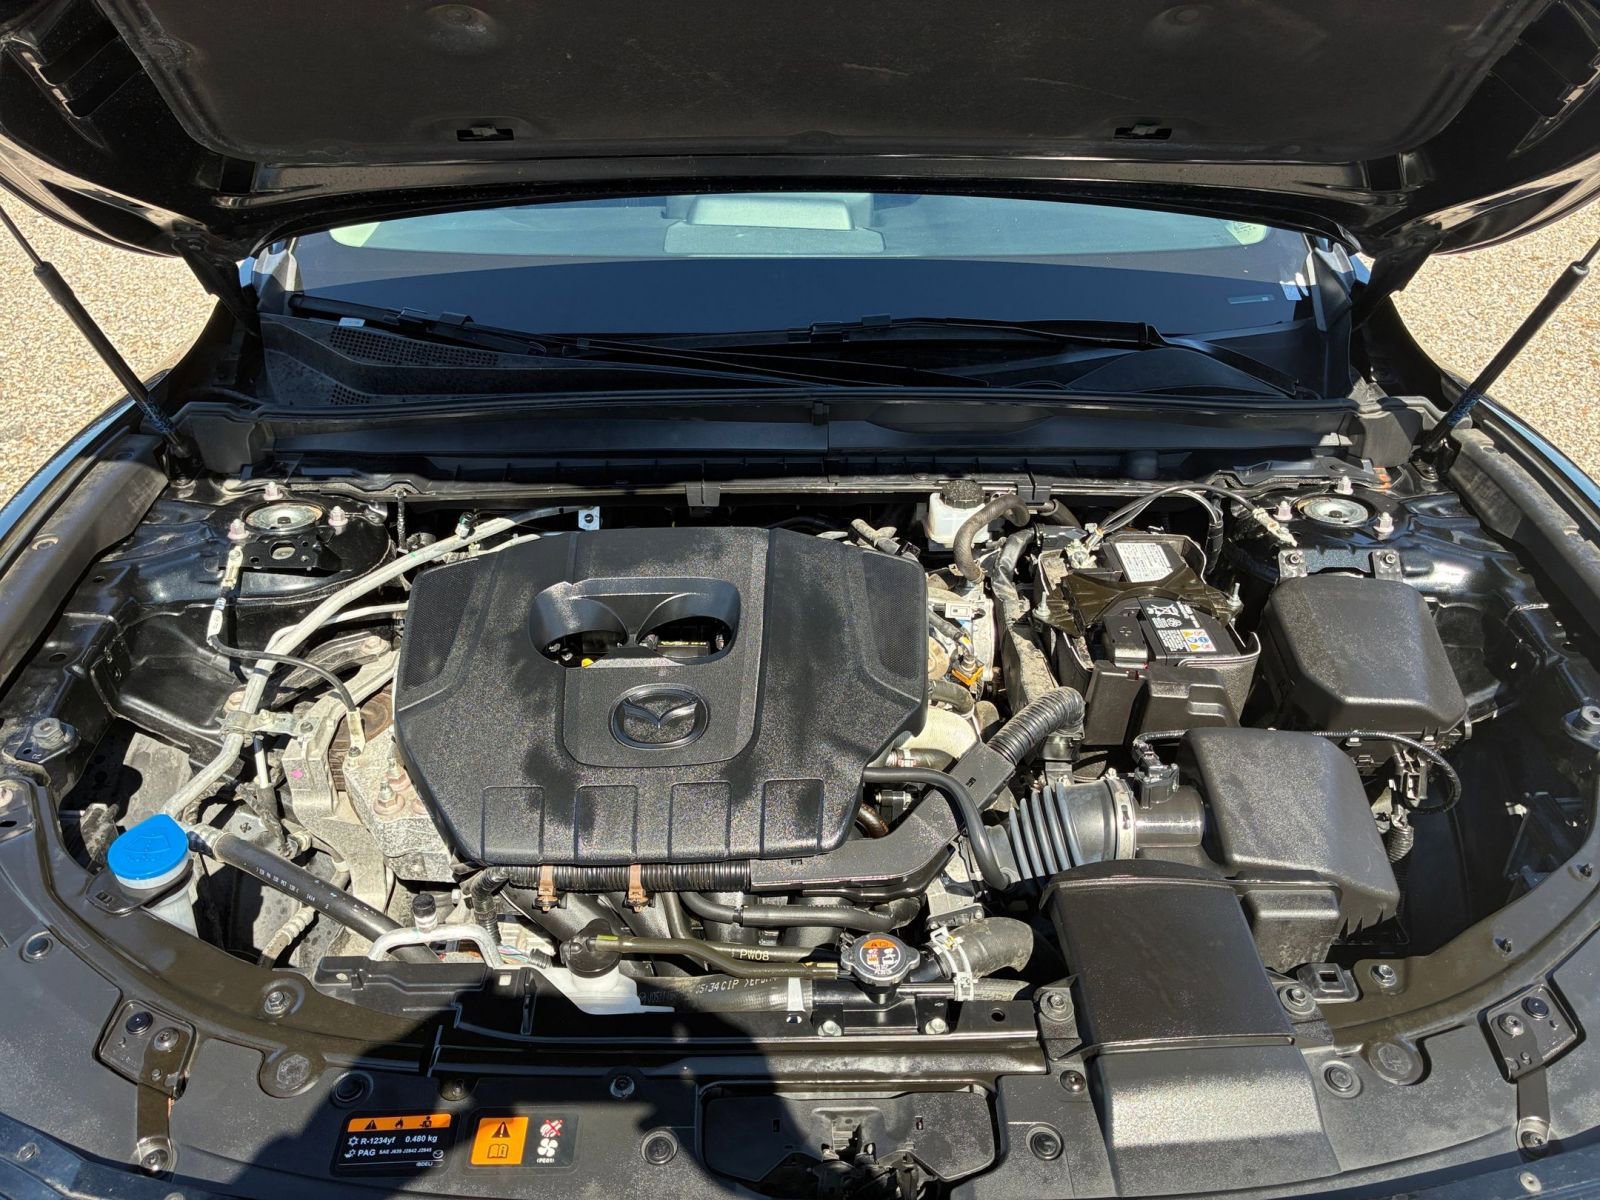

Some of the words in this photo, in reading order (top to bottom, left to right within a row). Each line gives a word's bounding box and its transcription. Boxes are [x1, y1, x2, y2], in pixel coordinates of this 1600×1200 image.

[739, 949, 770, 962] PW08
[360, 1136, 396, 1146] R-1234yf
[405, 1134, 426, 1143] 0.480
[427, 1134, 438, 1144] kg
[357, 1148, 376, 1157] PAG
